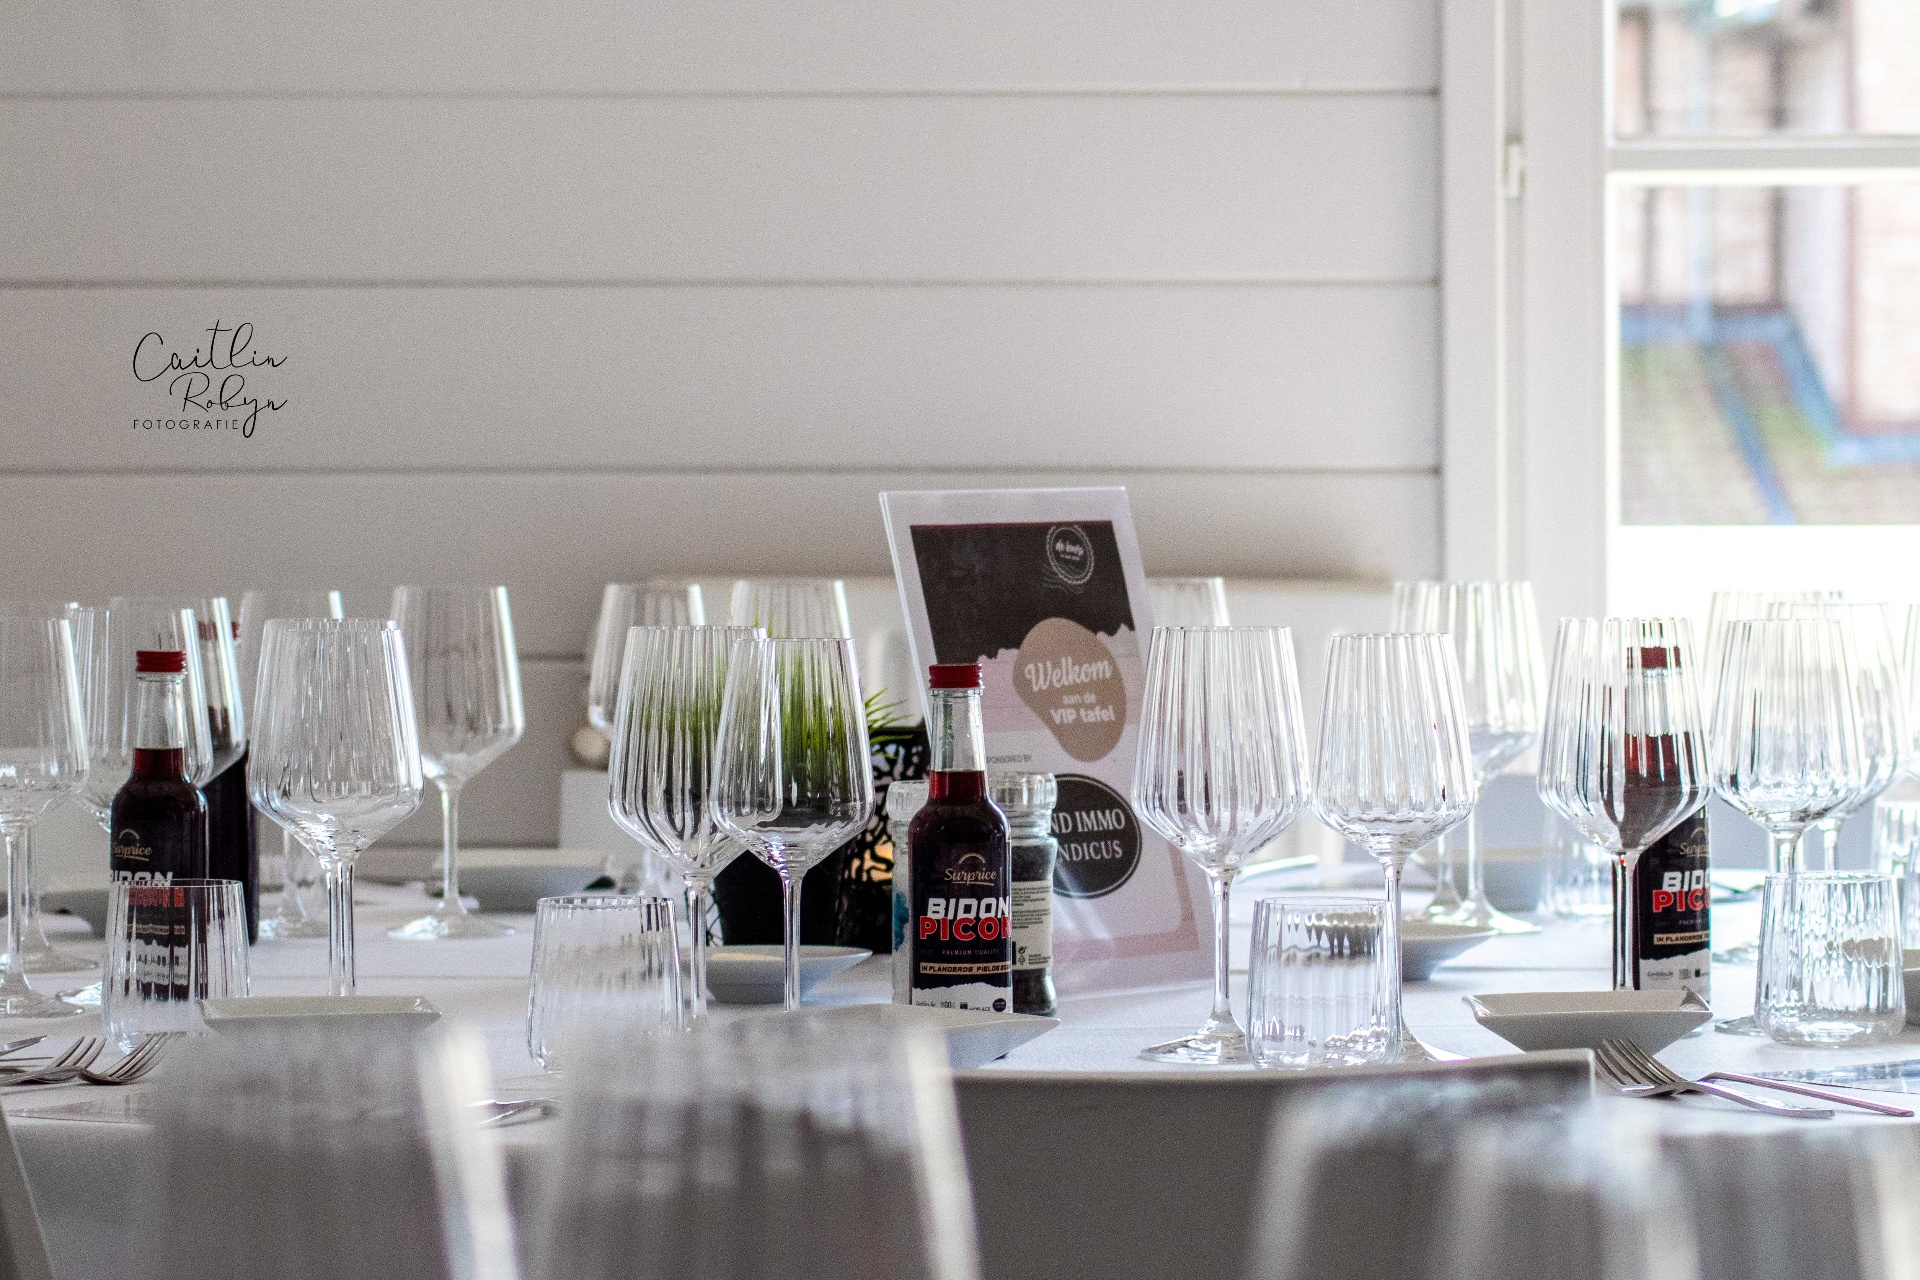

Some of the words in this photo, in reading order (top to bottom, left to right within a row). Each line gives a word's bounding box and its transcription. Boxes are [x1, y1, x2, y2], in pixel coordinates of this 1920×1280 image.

[1025, 656, 1112, 691] Welkom
[1050, 708, 1077, 724] VIP
[1080, 705, 1115, 722] tafel
[1075, 809, 1125, 832] IMMO
[944, 867, 998, 886] Surprice
[926, 895, 1010, 920] BIDON
